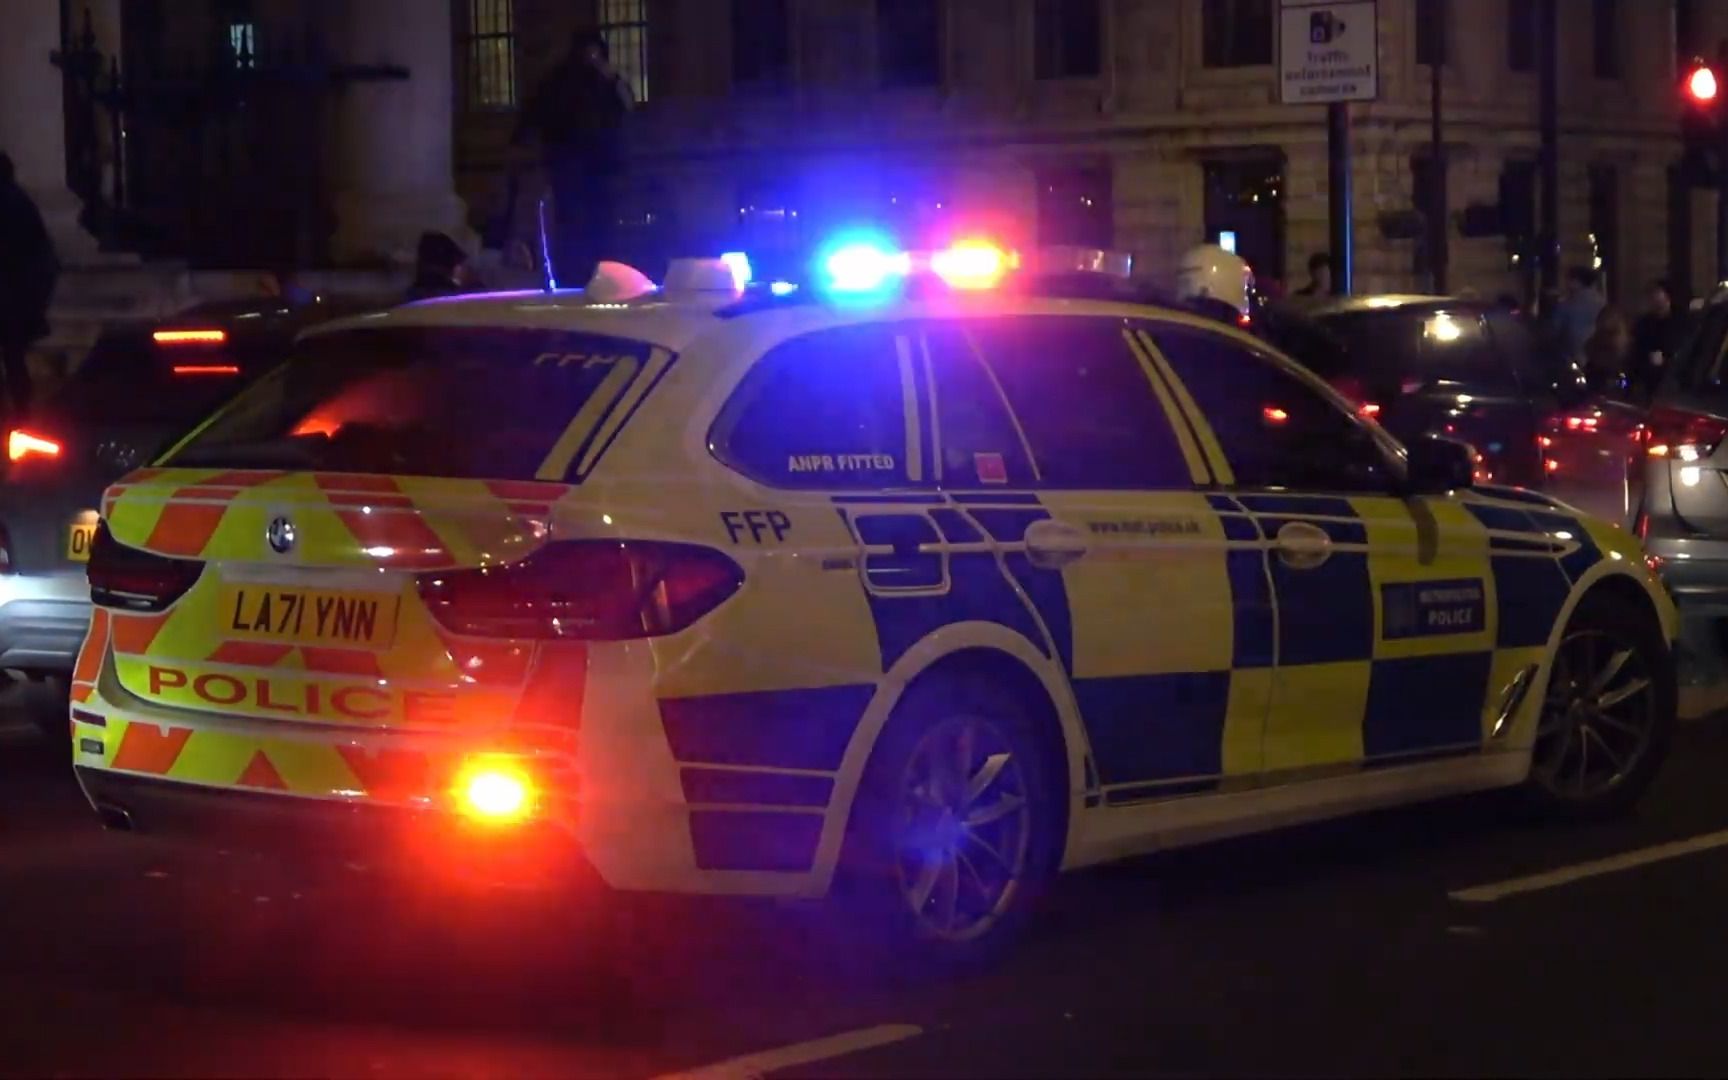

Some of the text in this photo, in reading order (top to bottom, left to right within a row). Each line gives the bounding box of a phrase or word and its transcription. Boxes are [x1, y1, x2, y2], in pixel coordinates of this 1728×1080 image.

[788, 454, 895, 473] ANPR FITTED
[719, 510, 792, 545] FFP
[232, 590, 377, 641] LA71 YNN
[1428, 607, 1473, 625] POLICE
[149, 665, 458, 724] POLICE
